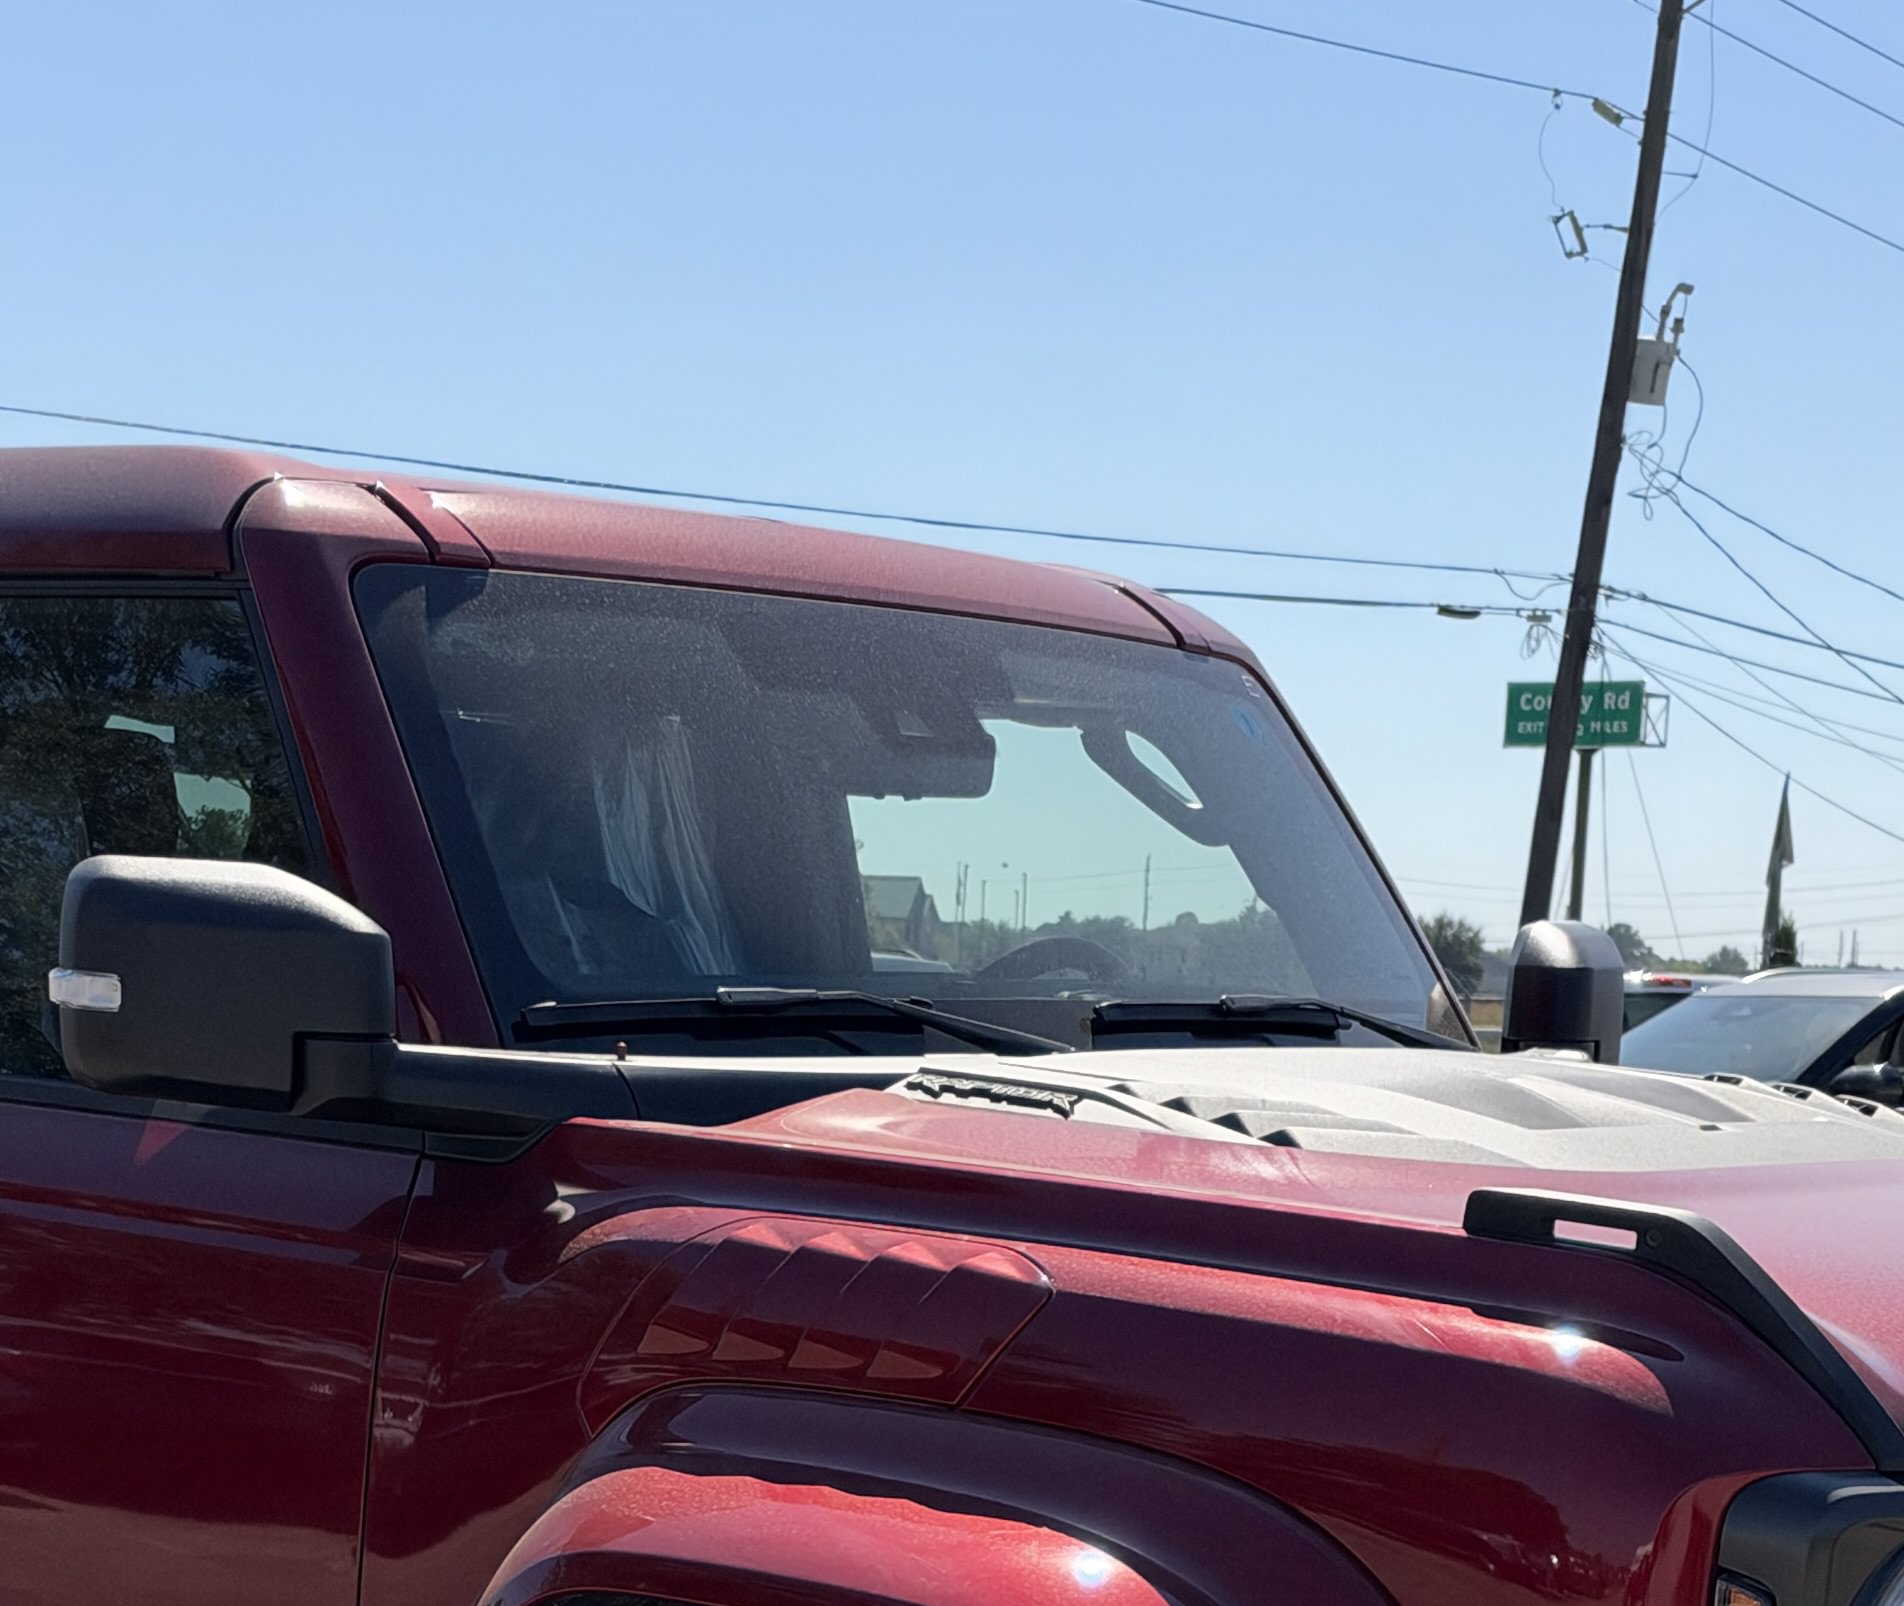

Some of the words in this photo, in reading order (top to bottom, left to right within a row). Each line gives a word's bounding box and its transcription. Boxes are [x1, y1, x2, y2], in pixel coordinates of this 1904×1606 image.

[1604, 691, 1631, 710] Rd
[1518, 721, 1545, 734] EXIT
[1590, 720, 1629, 733] MILES
